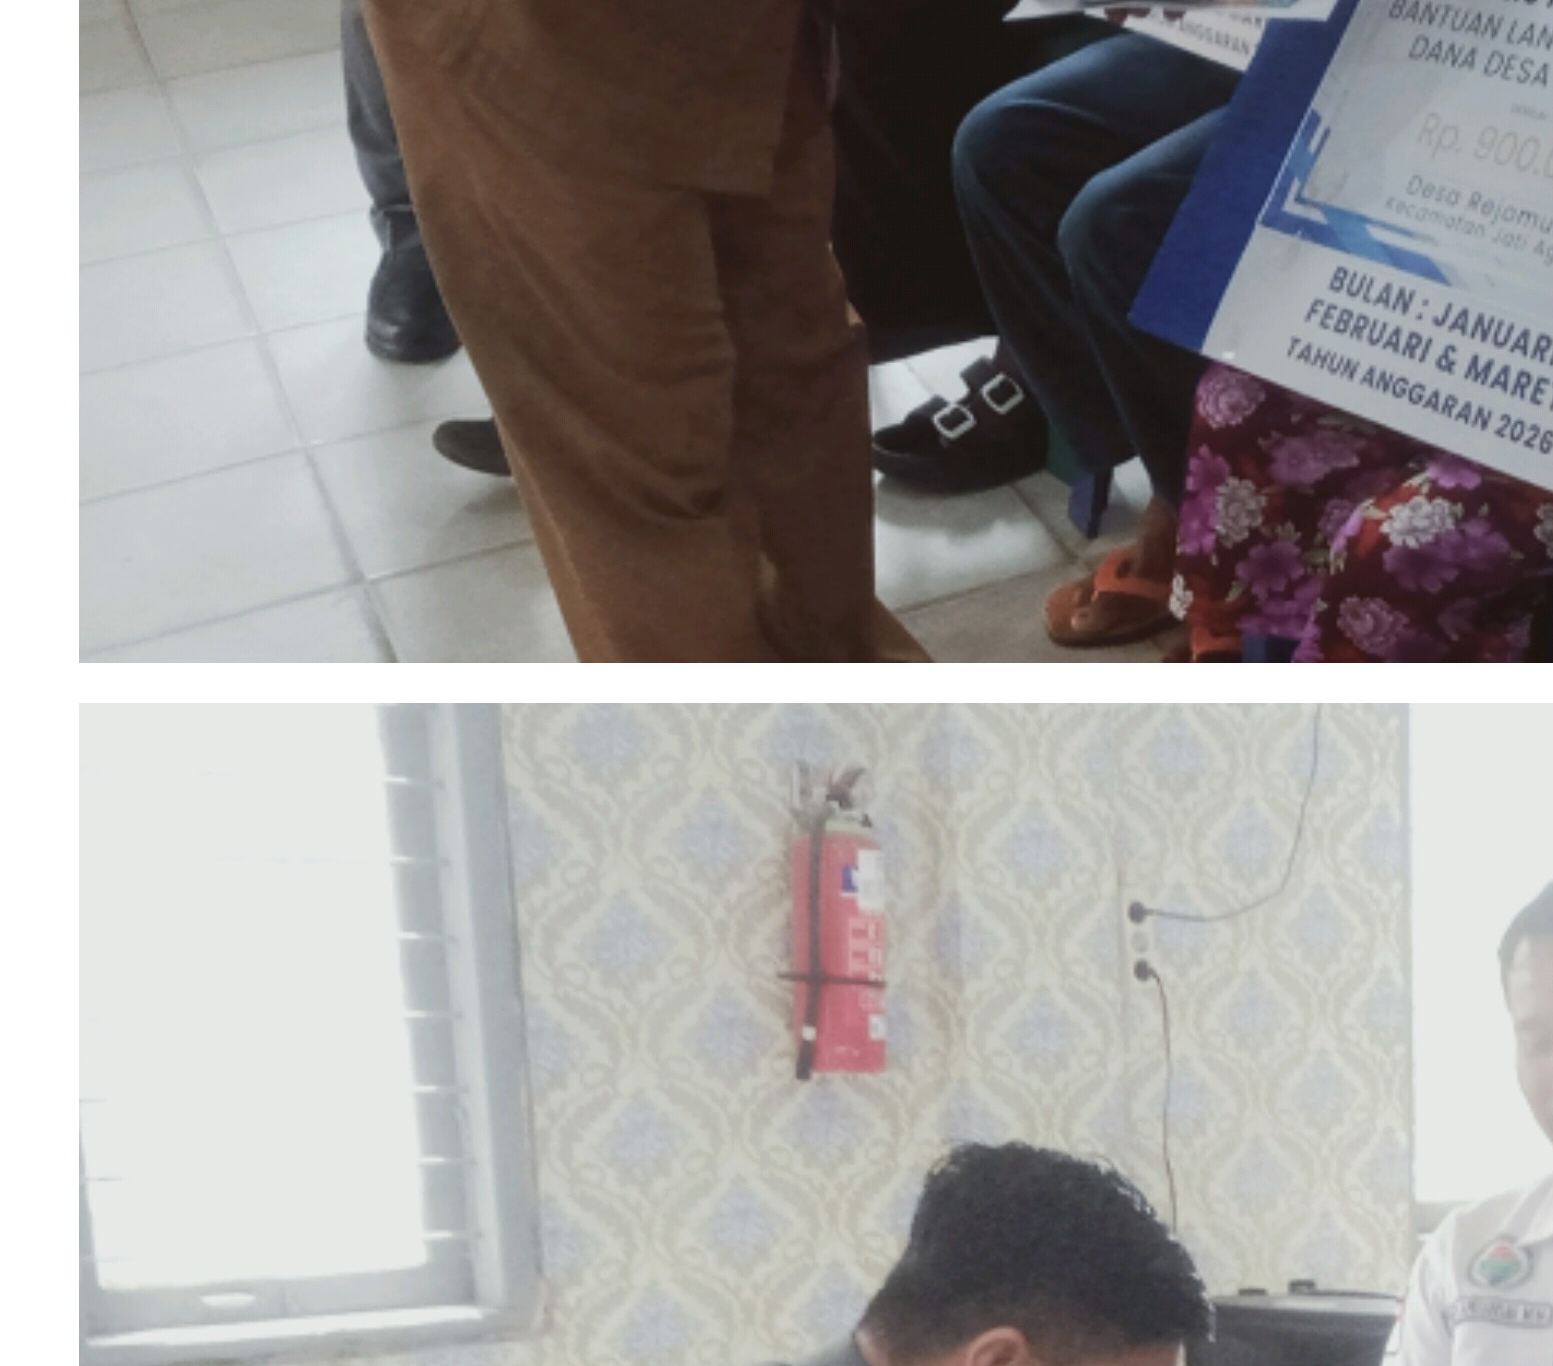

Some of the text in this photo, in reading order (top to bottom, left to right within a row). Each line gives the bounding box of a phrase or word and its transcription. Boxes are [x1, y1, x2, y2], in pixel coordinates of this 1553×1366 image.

[1408, 33, 1478, 71] DANA
[1482, 49, 1549, 88] DESA
[1418, 112, 1462, 160] Rp.
[1405, 174, 1462, 206] Desa
[1384, 195, 1486, 238] Kecamatan
[1329, 266, 1415, 316] BULAN
[1304, 299, 1433, 364] FEBRUARI
[1435, 343, 1458, 376] &
[1287, 336, 1361, 382] TAHUN
[1360, 364, 1492, 431] ANGGARAN
